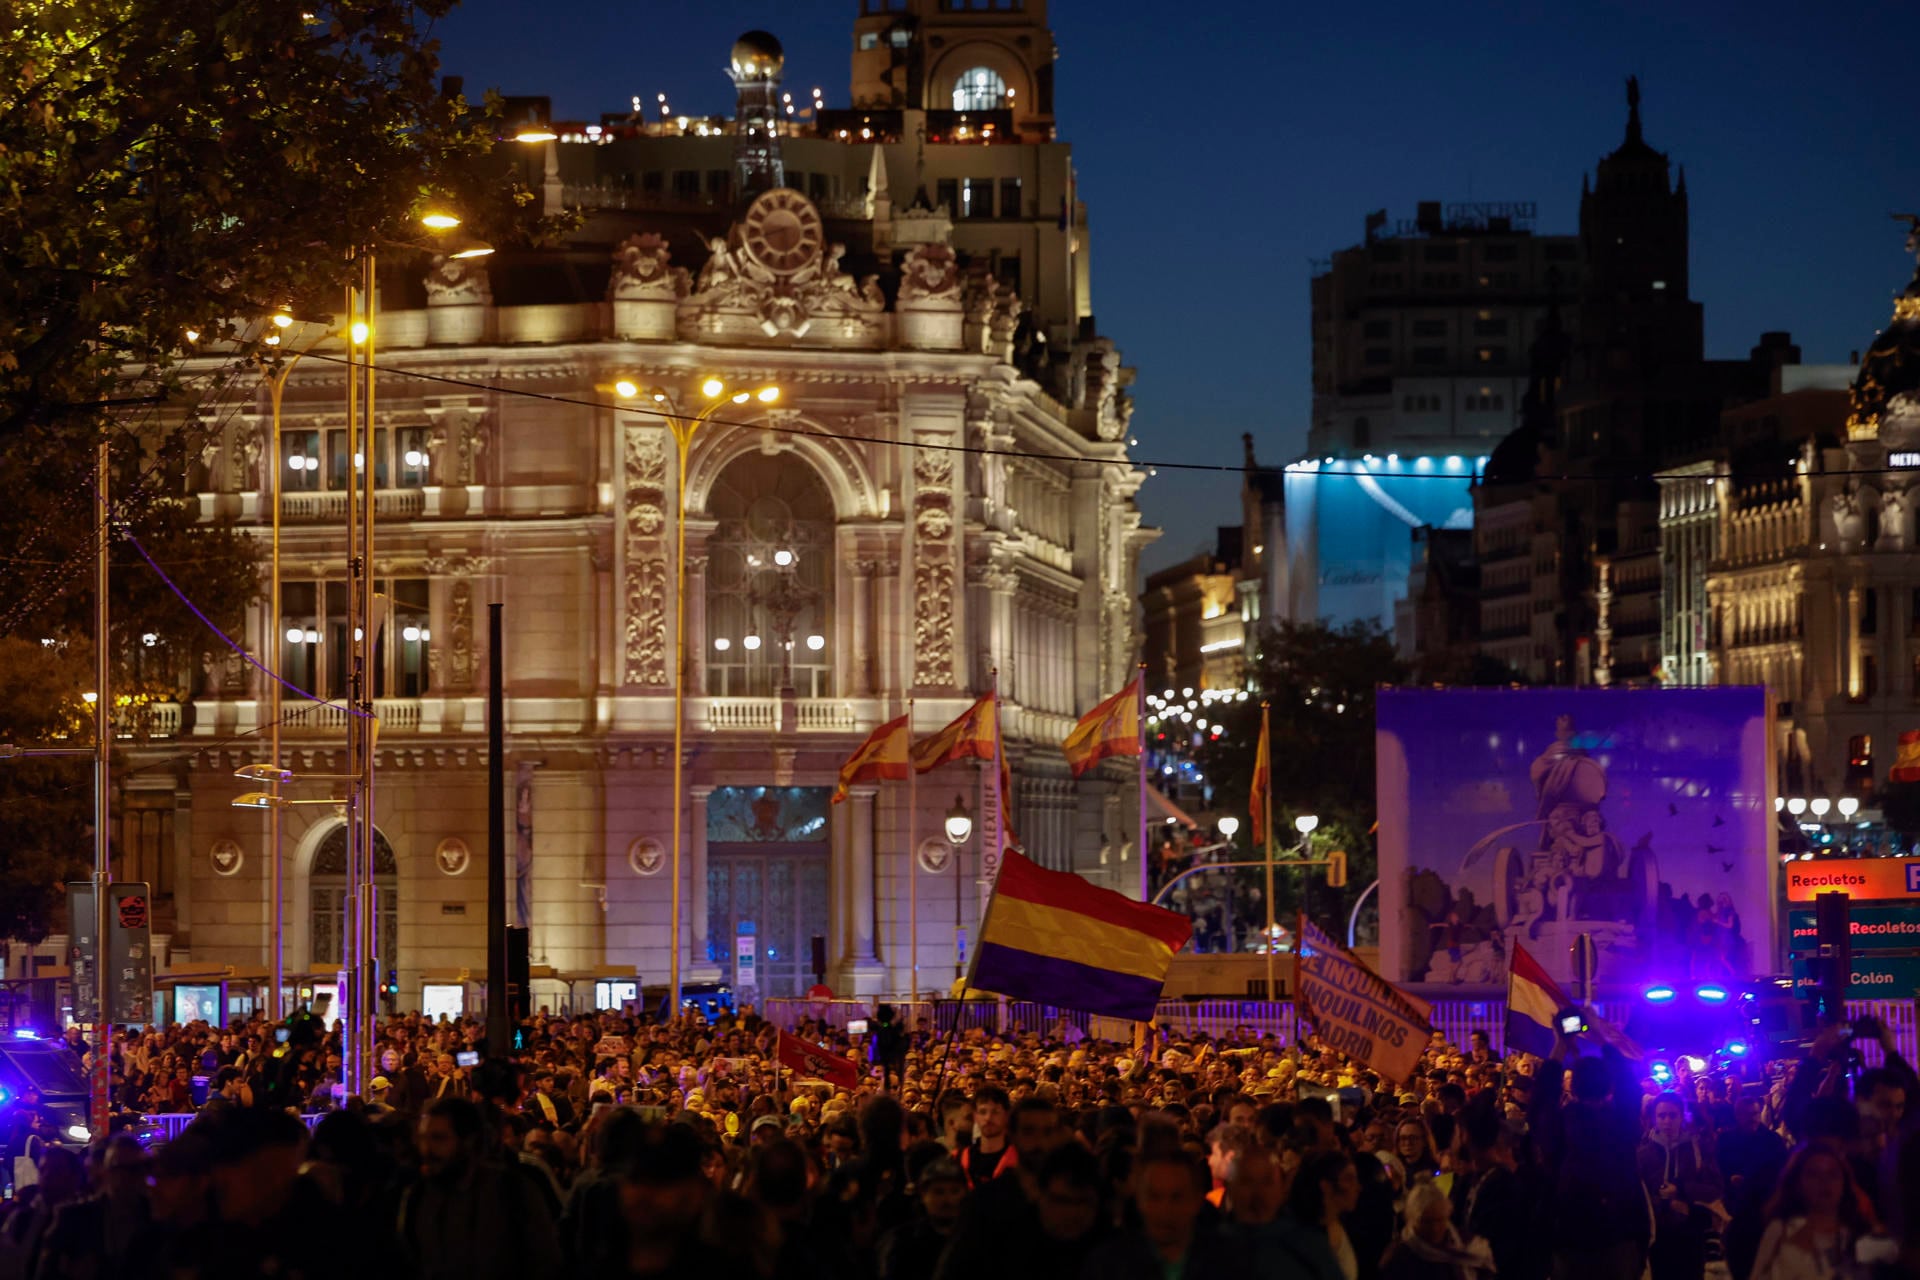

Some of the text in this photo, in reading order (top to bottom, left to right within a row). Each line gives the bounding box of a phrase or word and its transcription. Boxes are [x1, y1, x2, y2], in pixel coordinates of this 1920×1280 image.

[1792, 874, 1866, 887] Recoletos
[1793, 928, 1818, 938] pase
[1850, 971, 1894, 985] Colón
[1303, 978, 1409, 1048] INQUILINOS
